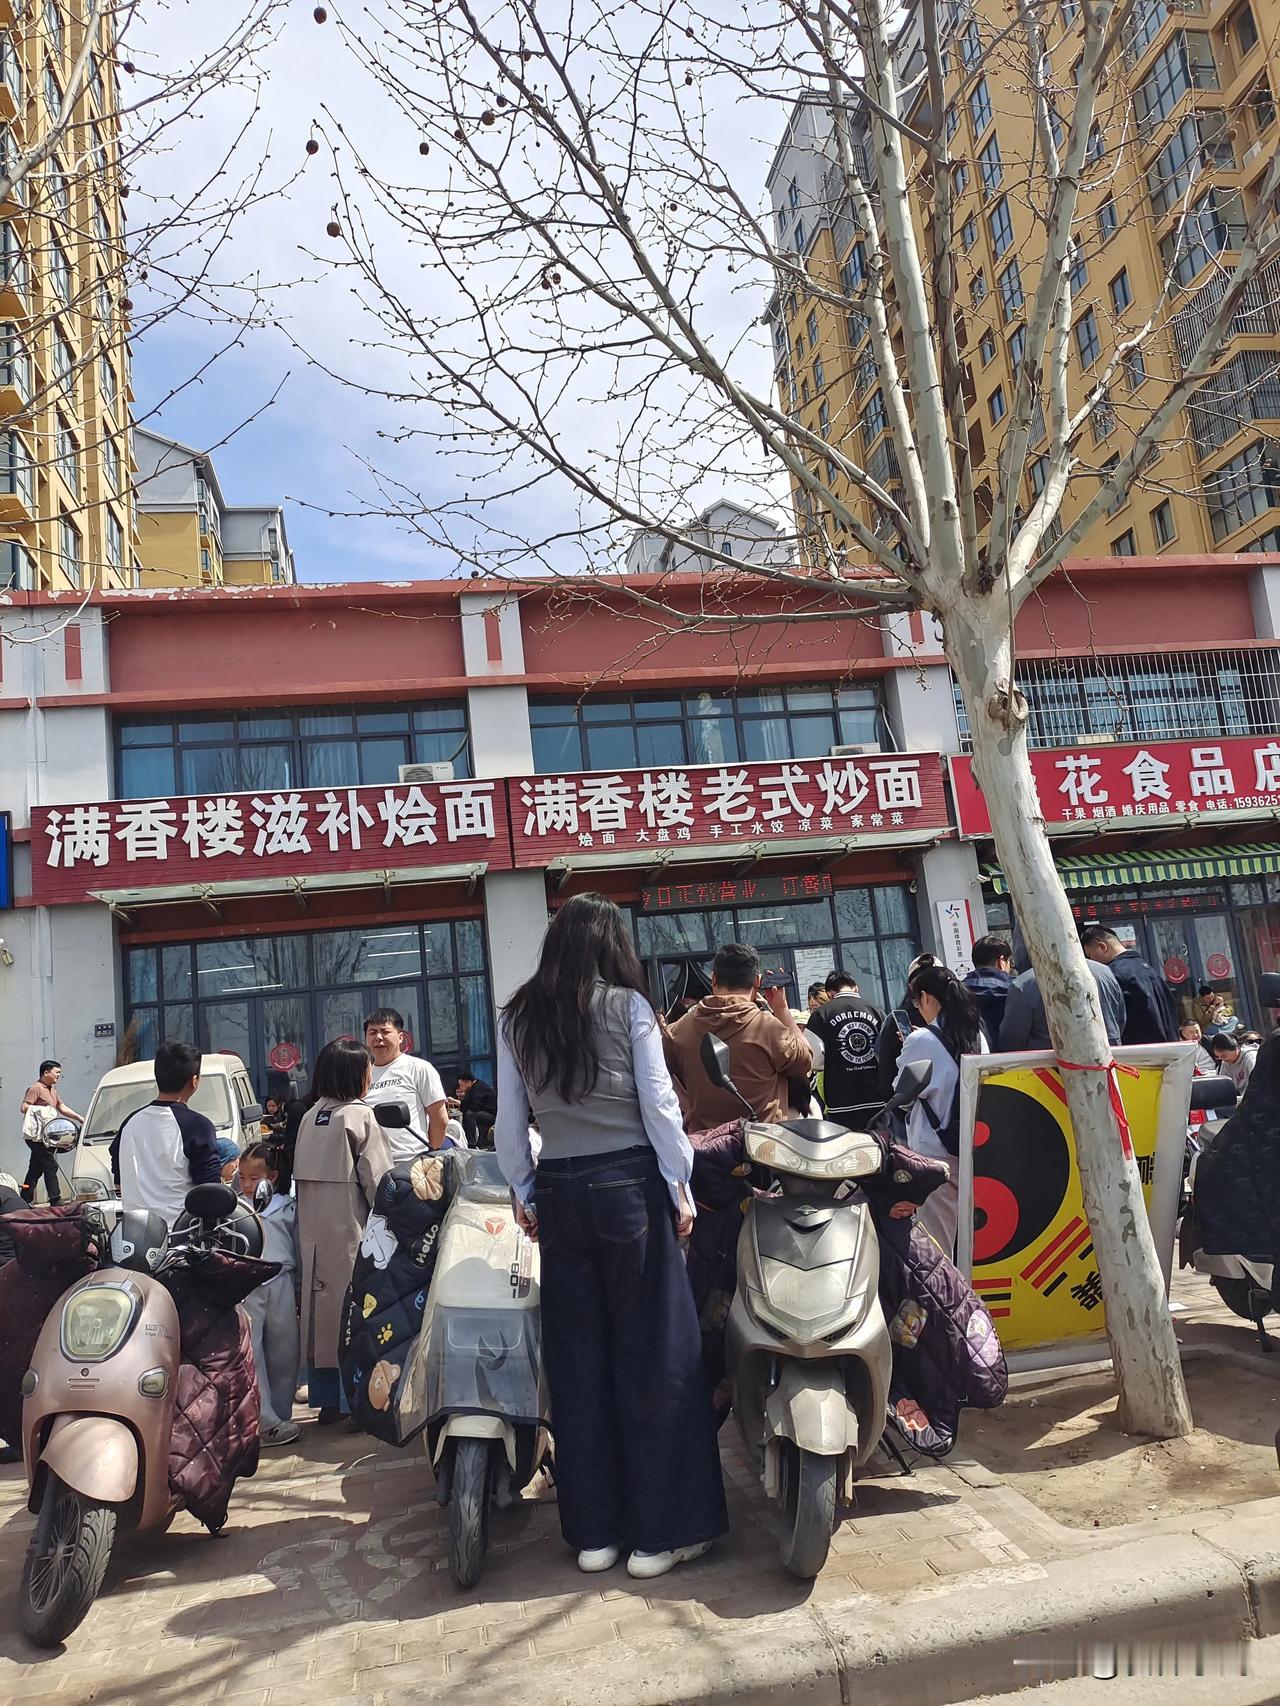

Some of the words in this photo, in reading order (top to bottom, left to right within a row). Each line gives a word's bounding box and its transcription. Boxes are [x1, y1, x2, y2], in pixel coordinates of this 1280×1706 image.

[520, 760, 922, 836] 满香楼老式炒面
[1029, 742, 1280, 807] 花食品店
[46, 782, 496, 868] 满香楼滋补烩面
[578, 830, 616, 847] 烩面
[635, 826, 692, 843] 大盘鸡
[709, 819, 785, 839] 手工水饺
[798, 816, 834, 832] 凉菜
[850, 811, 905, 828] 家常菜
[1062, 807, 1086, 821] 干果
[1092, 805, 1117, 819] 烟酒
[1121, 801, 1170, 817] 婚庆用品
[1175, 799, 1199, 812] 零食
[830, 1010, 878, 1026] DORAEMON
